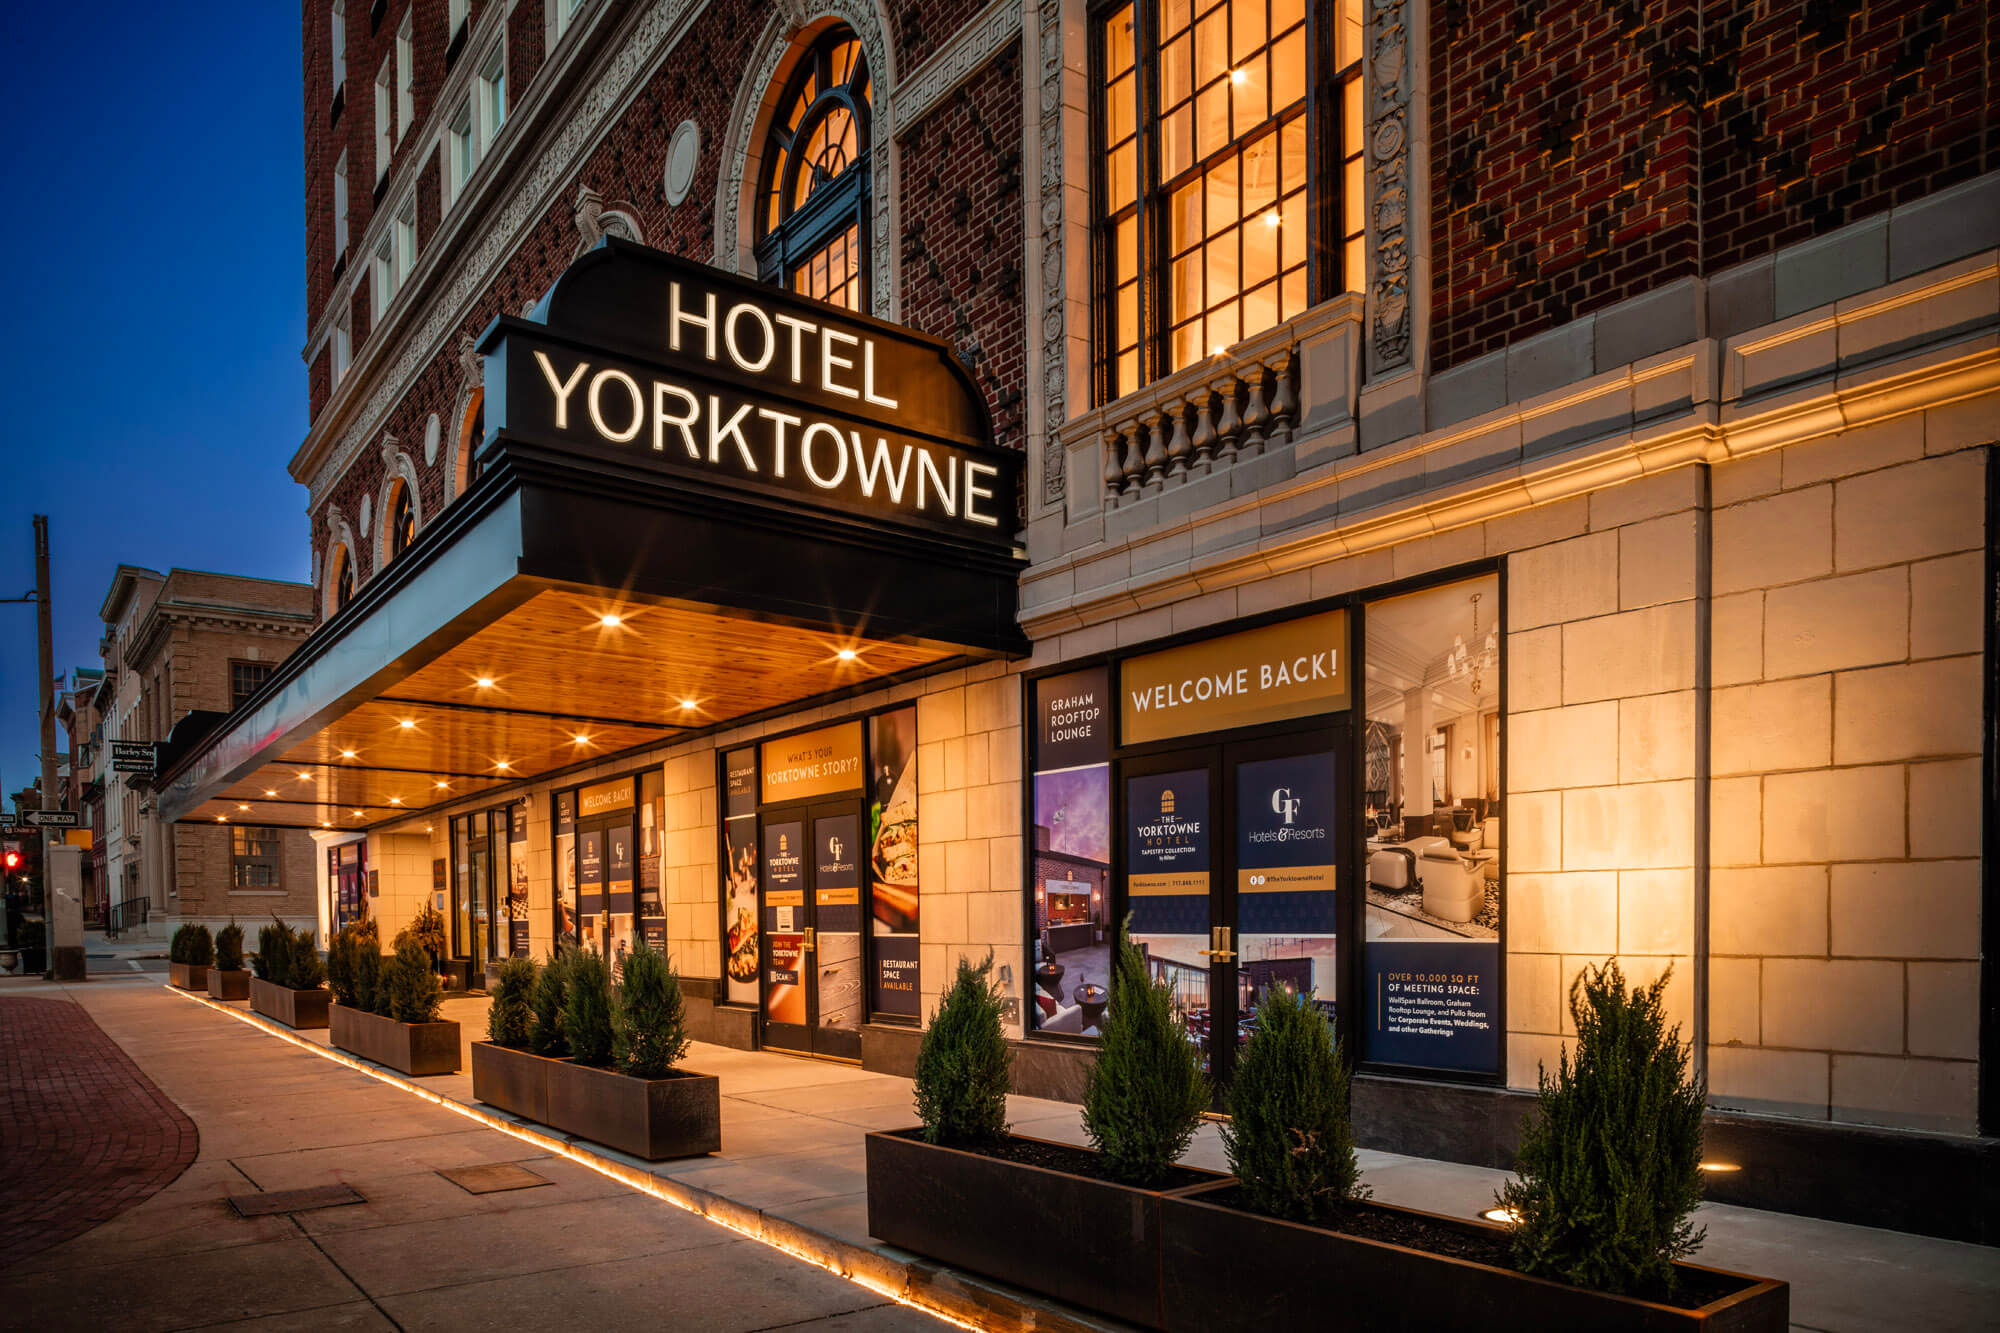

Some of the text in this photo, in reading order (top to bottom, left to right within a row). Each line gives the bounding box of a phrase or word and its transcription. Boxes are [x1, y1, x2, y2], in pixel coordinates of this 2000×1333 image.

[669, 281, 898, 409] HOTEL
[532, 350, 999, 527] YORKTOWNE
[1132, 649, 1337, 713] WELCOME BACK!
[1051, 693, 1093, 711] GRAHAM
[1051, 707, 1100, 727] ROOFTOP
[1051, 725, 1092, 743] LOUNGE
[787, 746, 832, 763] WHAT'S YOUR
[767, 756, 858, 785] YORKTOWNE STORY?
[584, 793, 612, 809] WELCOME
[57, 815, 73, 823] WAY
[1161, 815, 1175, 823] THE
[1137, 822, 1200, 837] YORKTOWNE
[1147, 835, 1190, 846] HOTEL
[883, 959, 918, 969] RESTAURANT
[883, 970, 900, 979] SPACE
[1388, 972, 1412, 981] OVER
[1451, 974, 1464, 984] SQ
[1467, 975, 1479, 984] FT
[883, 981, 913, 991] AVAILABLE
[1388, 983, 1480, 995] OF MEETING SPACE:
[1388, 996, 1471, 1007] WellSpan Ballroom, Graham
[1388, 1006, 1412, 1015] Rooftop
[1413, 1008, 1436, 1016] Lounge,
[1467, 1010, 1486, 1018] Room
[1388, 1015, 1490, 1030] for Corporate Events, Weddings,
[1388, 1025, 1454, 1037] and other Gatherings
